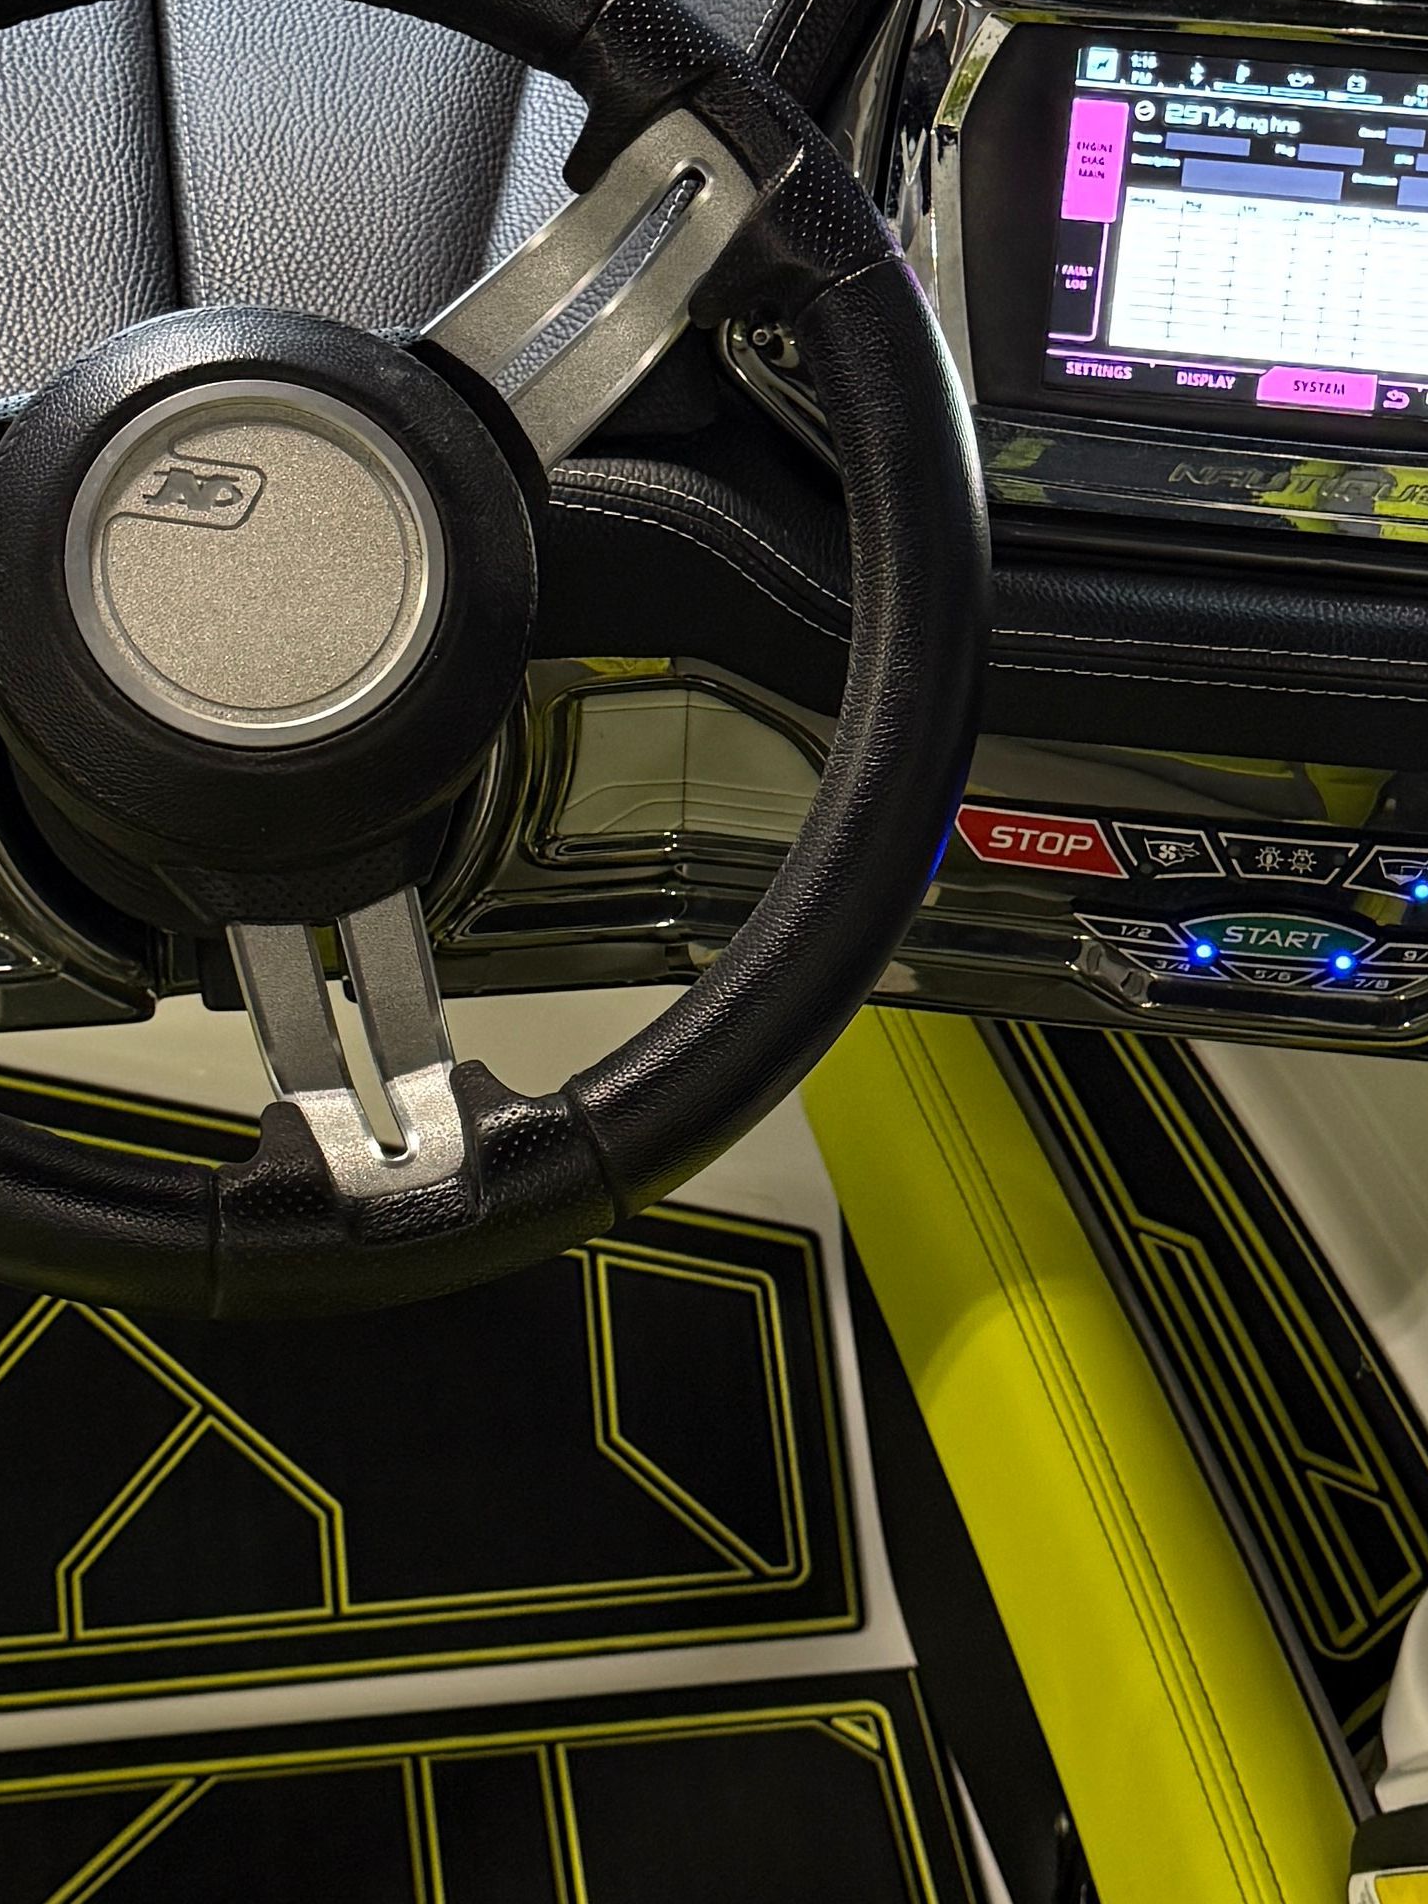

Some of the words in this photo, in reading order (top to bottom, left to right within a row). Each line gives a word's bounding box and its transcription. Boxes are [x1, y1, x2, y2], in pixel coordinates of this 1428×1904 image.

[1235, 114, 1270, 135] eng
[1270, 115, 1301, 135] hrs
[1061, 264, 1094, 278] FAULT
[1065, 279, 1088, 291] LOG
[1065, 361, 1133, 380] SETTINGS
[1176, 370, 1236, 390] DISPLAY
[1293, 379, 1346, 396] SYSTEM
[989, 825, 1093, 856] STOP
[1119, 924, 1152, 938] 1/2
[1222, 924, 1329, 949] START
[1155, 959, 1191, 973] 3/4
